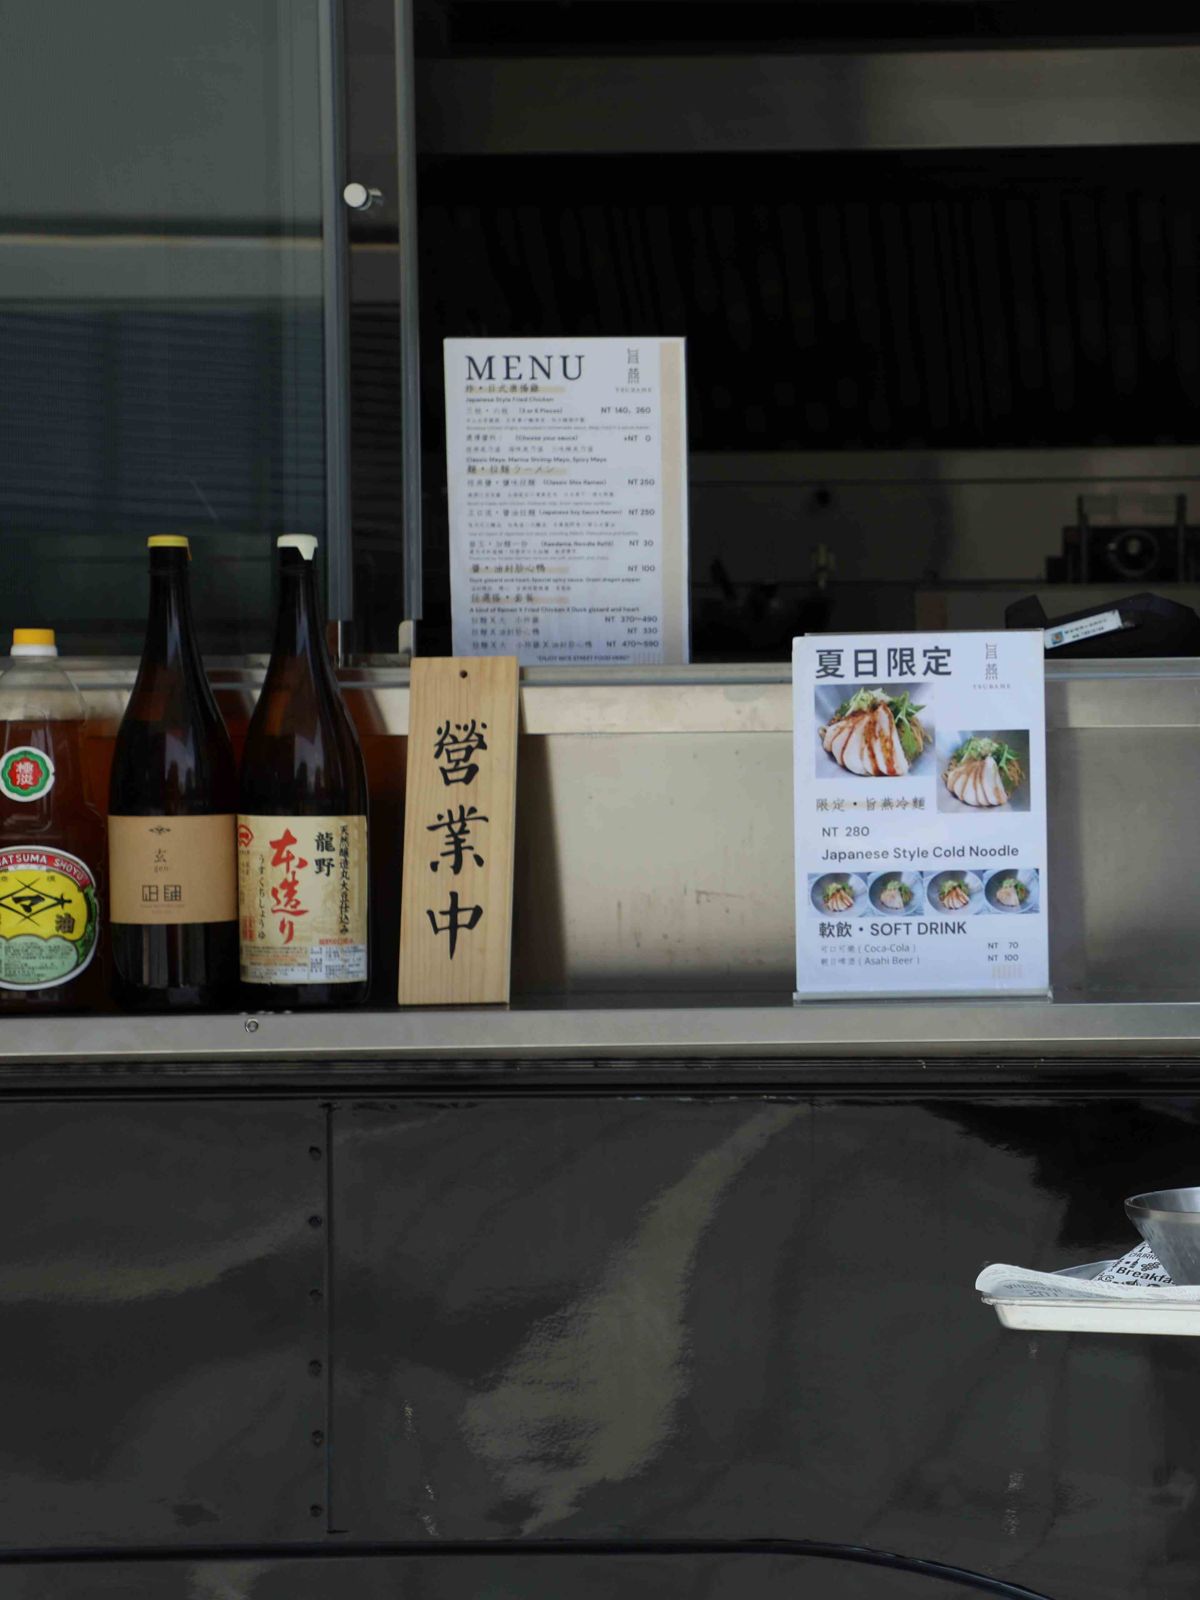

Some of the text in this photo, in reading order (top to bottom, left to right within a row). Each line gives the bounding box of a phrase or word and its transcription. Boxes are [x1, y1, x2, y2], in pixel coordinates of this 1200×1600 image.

[465, 355, 585, 381] MENU
[815, 645, 953, 679] 夏日限定
[426, 718, 490, 961] 營業中
[822, 826, 870, 837] NT 280
[314, 831, 336, 877] 龍野
[822, 845, 1020, 863] Japanese Style Cold Noodle
[269, 827, 310, 945] 本造り
[917, 921, 967, 936] DRINK
[988, 942, 1019, 950] NT 70
[988, 954, 1019, 962] NT 100
